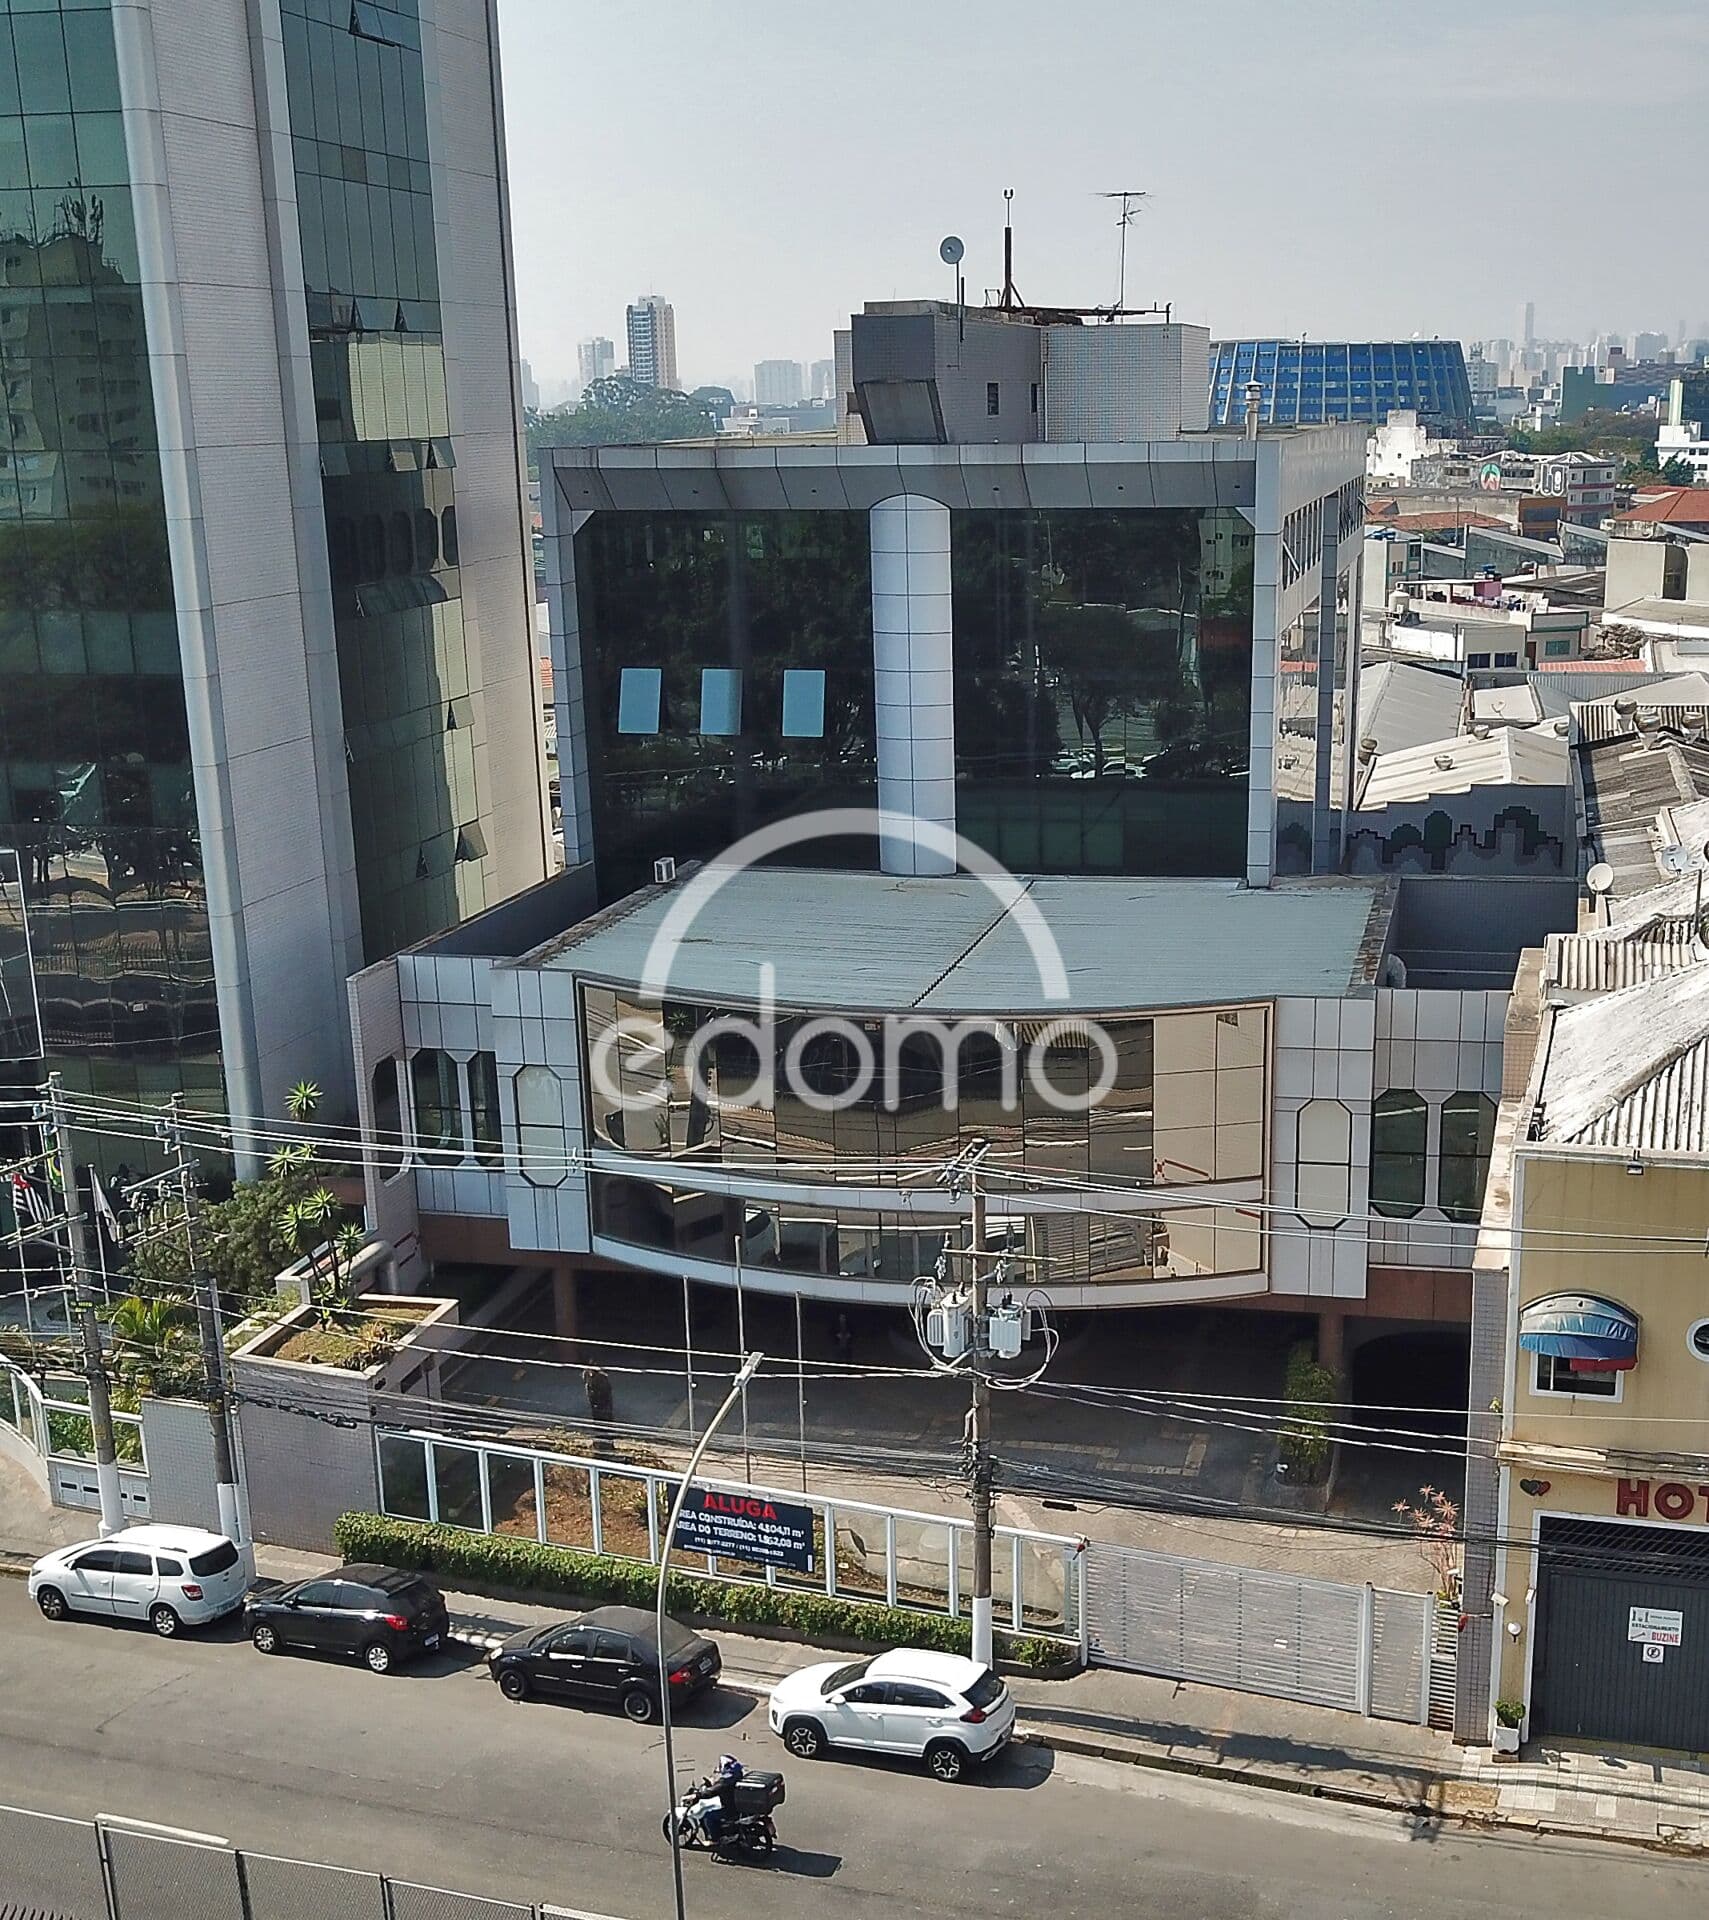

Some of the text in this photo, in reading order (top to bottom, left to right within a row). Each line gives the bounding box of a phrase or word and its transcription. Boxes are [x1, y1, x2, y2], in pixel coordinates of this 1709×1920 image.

[703, 1493, 778, 1520] ALUGA
[676, 1520, 697, 1532] REA
[698, 1524, 711, 1535] DO
[679, 1509, 697, 1520] REA
[698, 1512, 757, 1530] CONSTRUÍDA:
[1651, 1631, 1680, 1643] BUZINE
